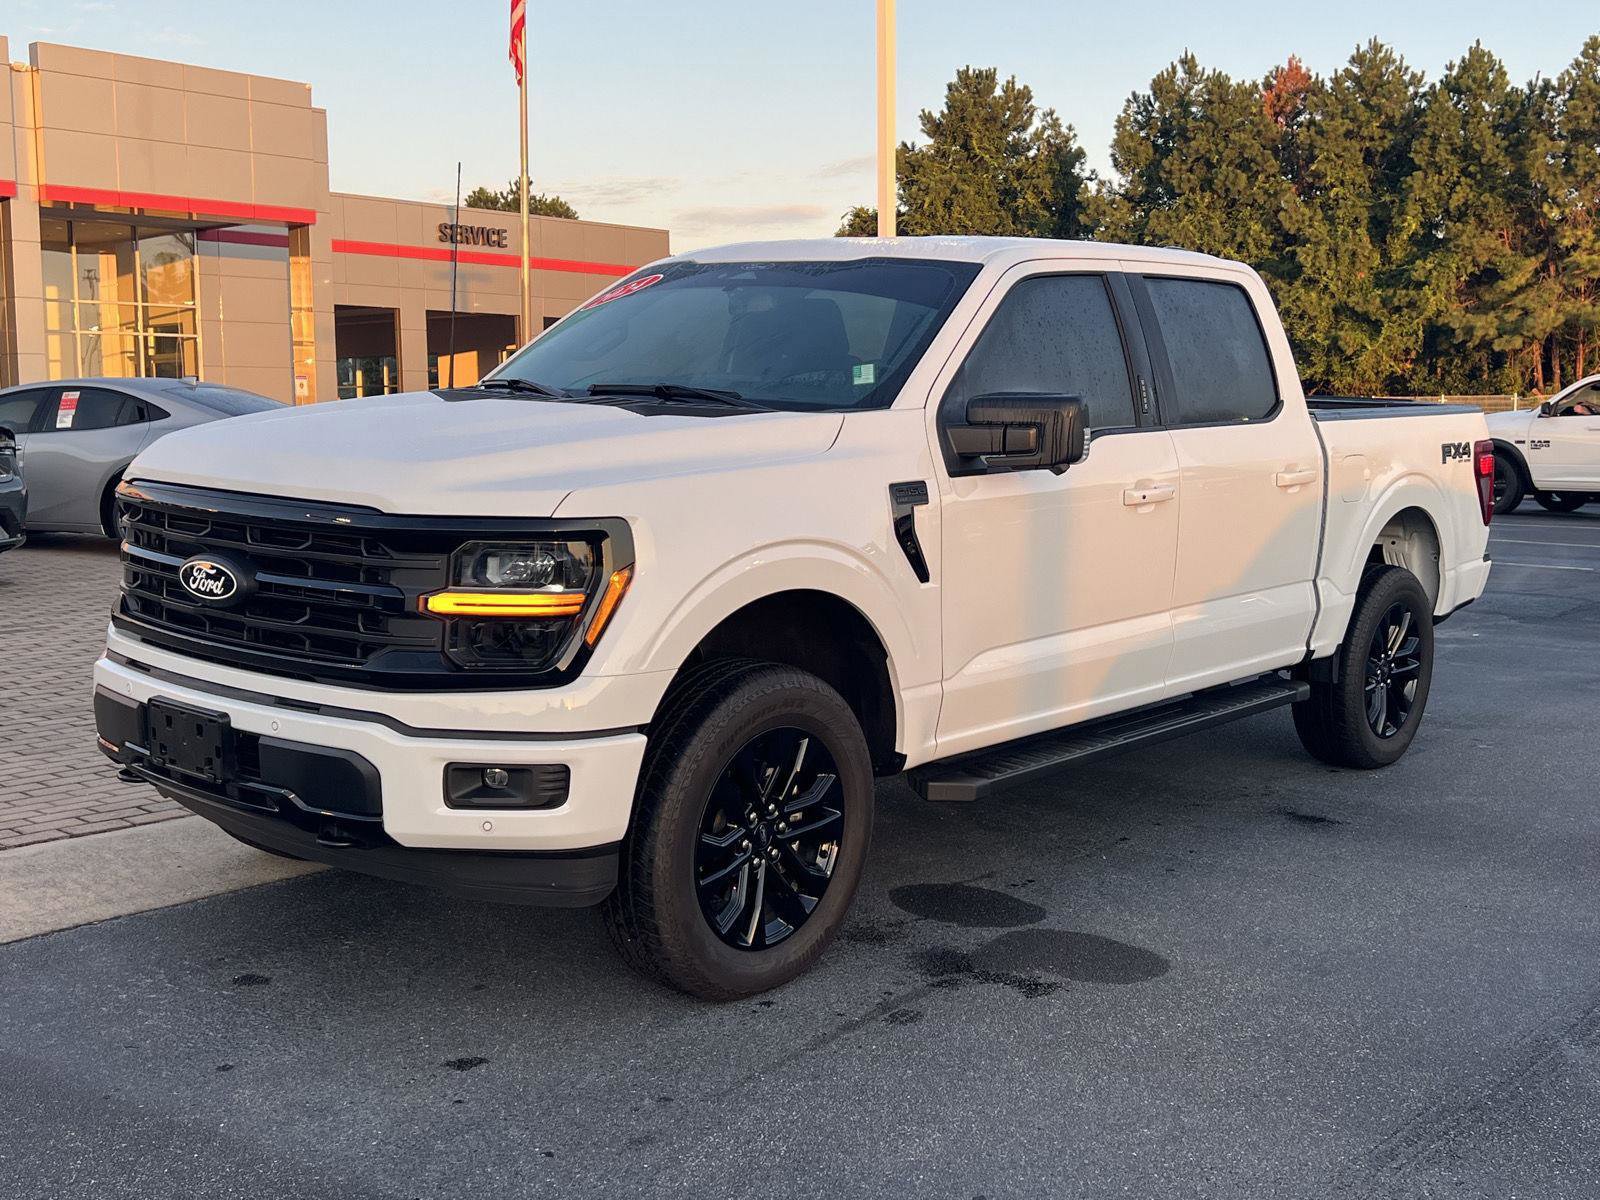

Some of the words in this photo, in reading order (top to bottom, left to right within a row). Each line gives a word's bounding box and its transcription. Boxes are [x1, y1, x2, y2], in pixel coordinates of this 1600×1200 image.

[438, 222, 508, 248] SERVICE
[1441, 442, 1471, 464] FX4
[189, 565, 225, 595] Ford
